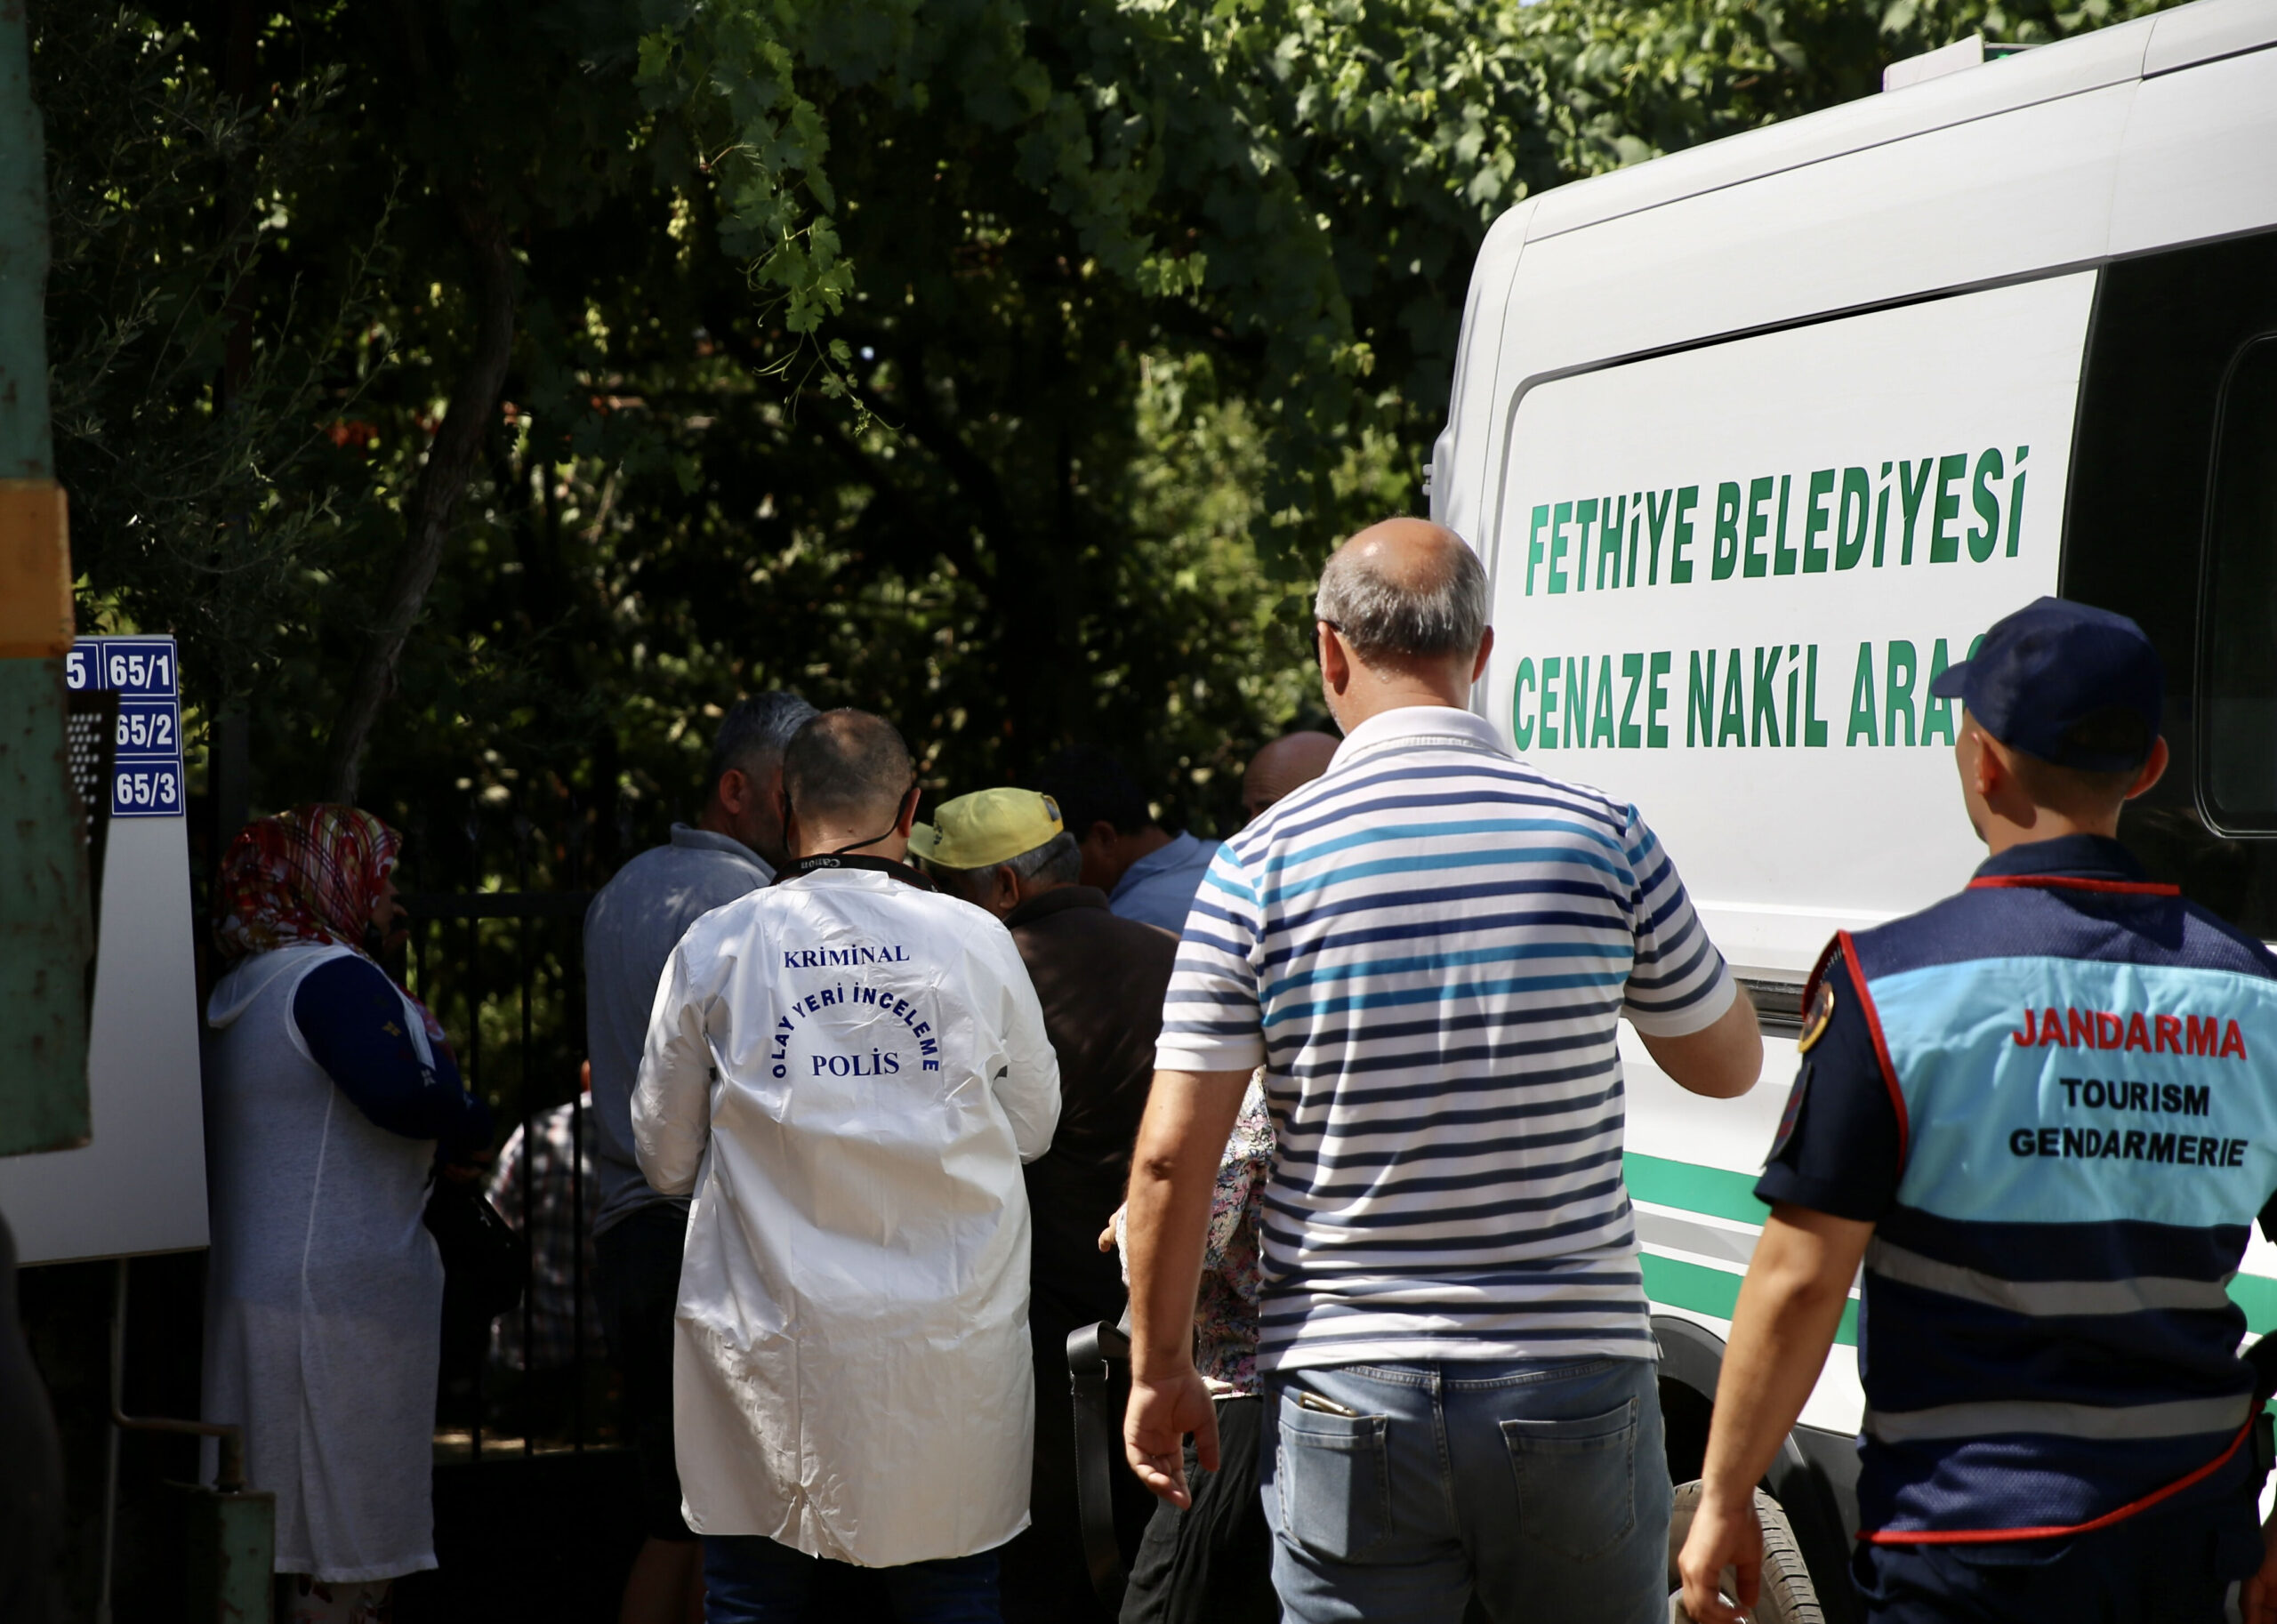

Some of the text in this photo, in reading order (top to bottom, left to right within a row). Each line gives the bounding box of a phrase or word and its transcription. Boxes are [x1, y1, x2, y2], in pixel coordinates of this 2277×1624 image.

[1525, 445, 2030, 596] FETHİYE BELEDİYESİ
[110, 655, 170, 689] 65/1
[1513, 633, 1987, 752] CENAZE NAKİL ARA
[116, 713, 173, 748] 65/2
[117, 772, 176, 808] 65/3
[801, 858, 841, 869] Canon
[783, 944, 910, 969] KRİMİNAL
[770, 981, 939, 1079] OLAY YERİ İNCELEME
[2012, 1007, 2248, 1061] JANDARMA
[811, 1048, 900, 1077] POLİS
[2059, 1078, 2210, 1116] TOURISM
[2009, 1127, 2249, 1168] GENDARMERIE
